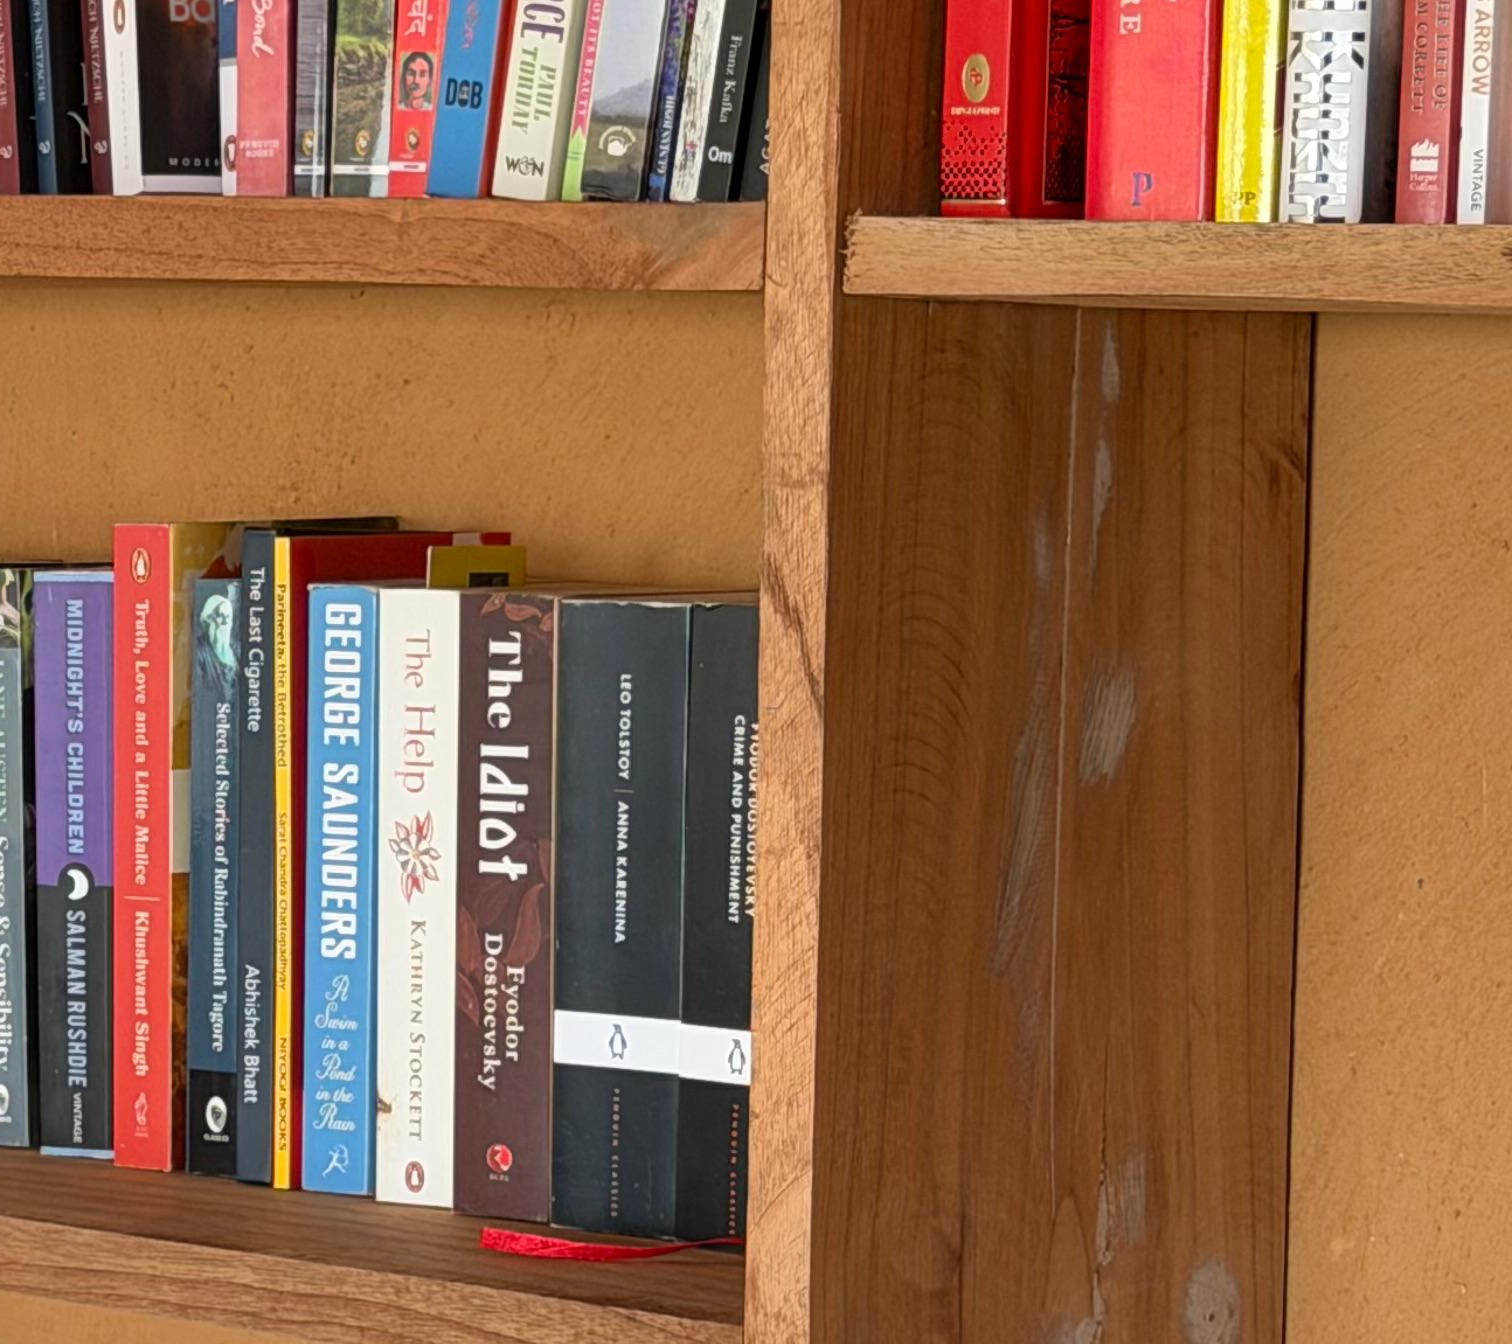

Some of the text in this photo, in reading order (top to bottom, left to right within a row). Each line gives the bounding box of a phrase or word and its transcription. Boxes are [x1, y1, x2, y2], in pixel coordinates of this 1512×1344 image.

[512, 47, 539, 134] TORDAY
[533, 64, 557, 121] PAUL
[394, 629, 436, 793] The Help
[487, 630, 523, 729] The
[320, 603, 362, 960] GEORGE SAUNDERS
[66, 910, 87, 1087] SALMAN RUSHDIE
[244, 964, 260, 1103] Abhishek Bhatt
[478, 933, 503, 1091] Dostoevsky
[505, 965, 525, 1062] Fyodor
[71, 1093, 83, 1144] VINTAGE
